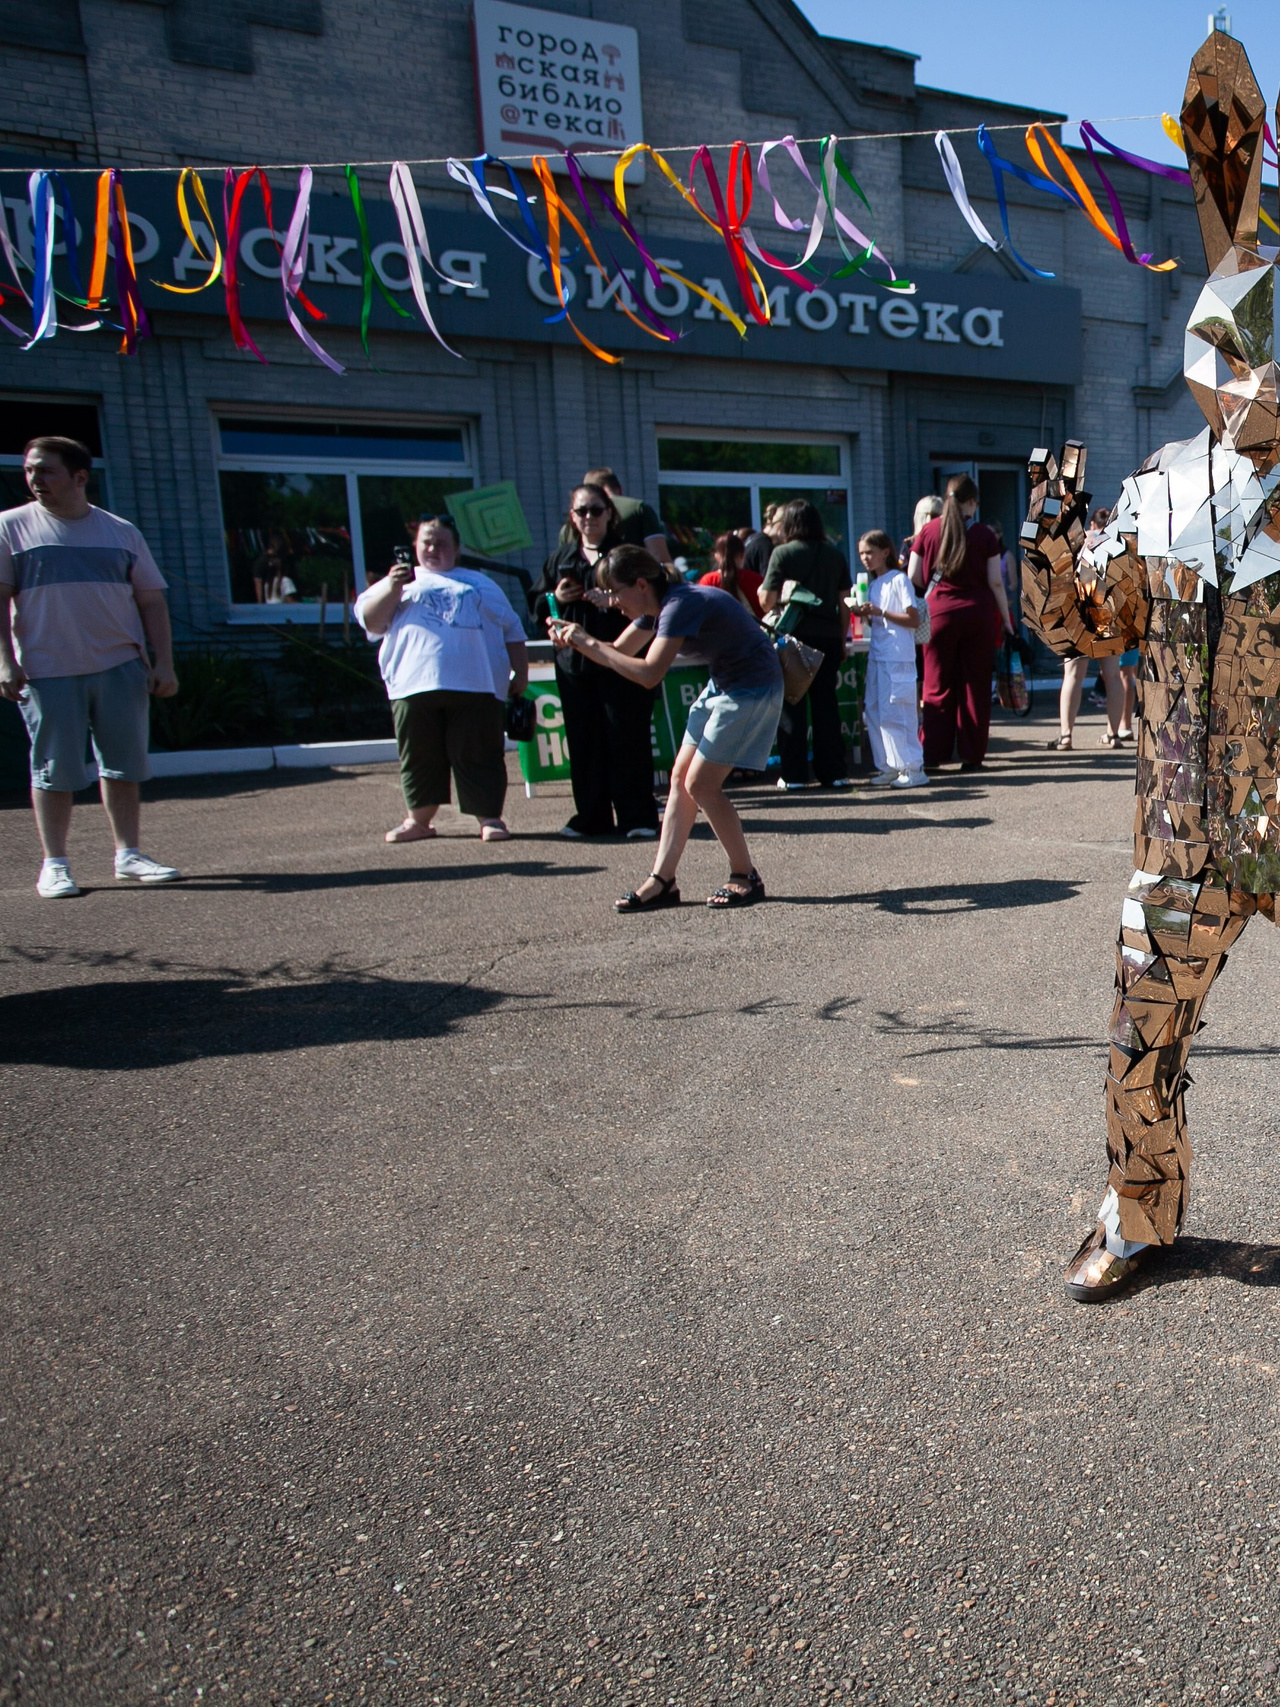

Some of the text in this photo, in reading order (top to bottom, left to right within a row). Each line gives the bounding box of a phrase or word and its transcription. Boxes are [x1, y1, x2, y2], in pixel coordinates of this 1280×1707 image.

[497, 25, 599, 64] город
[517, 56, 600, 87] ская
[498, 75, 622, 115] библио
